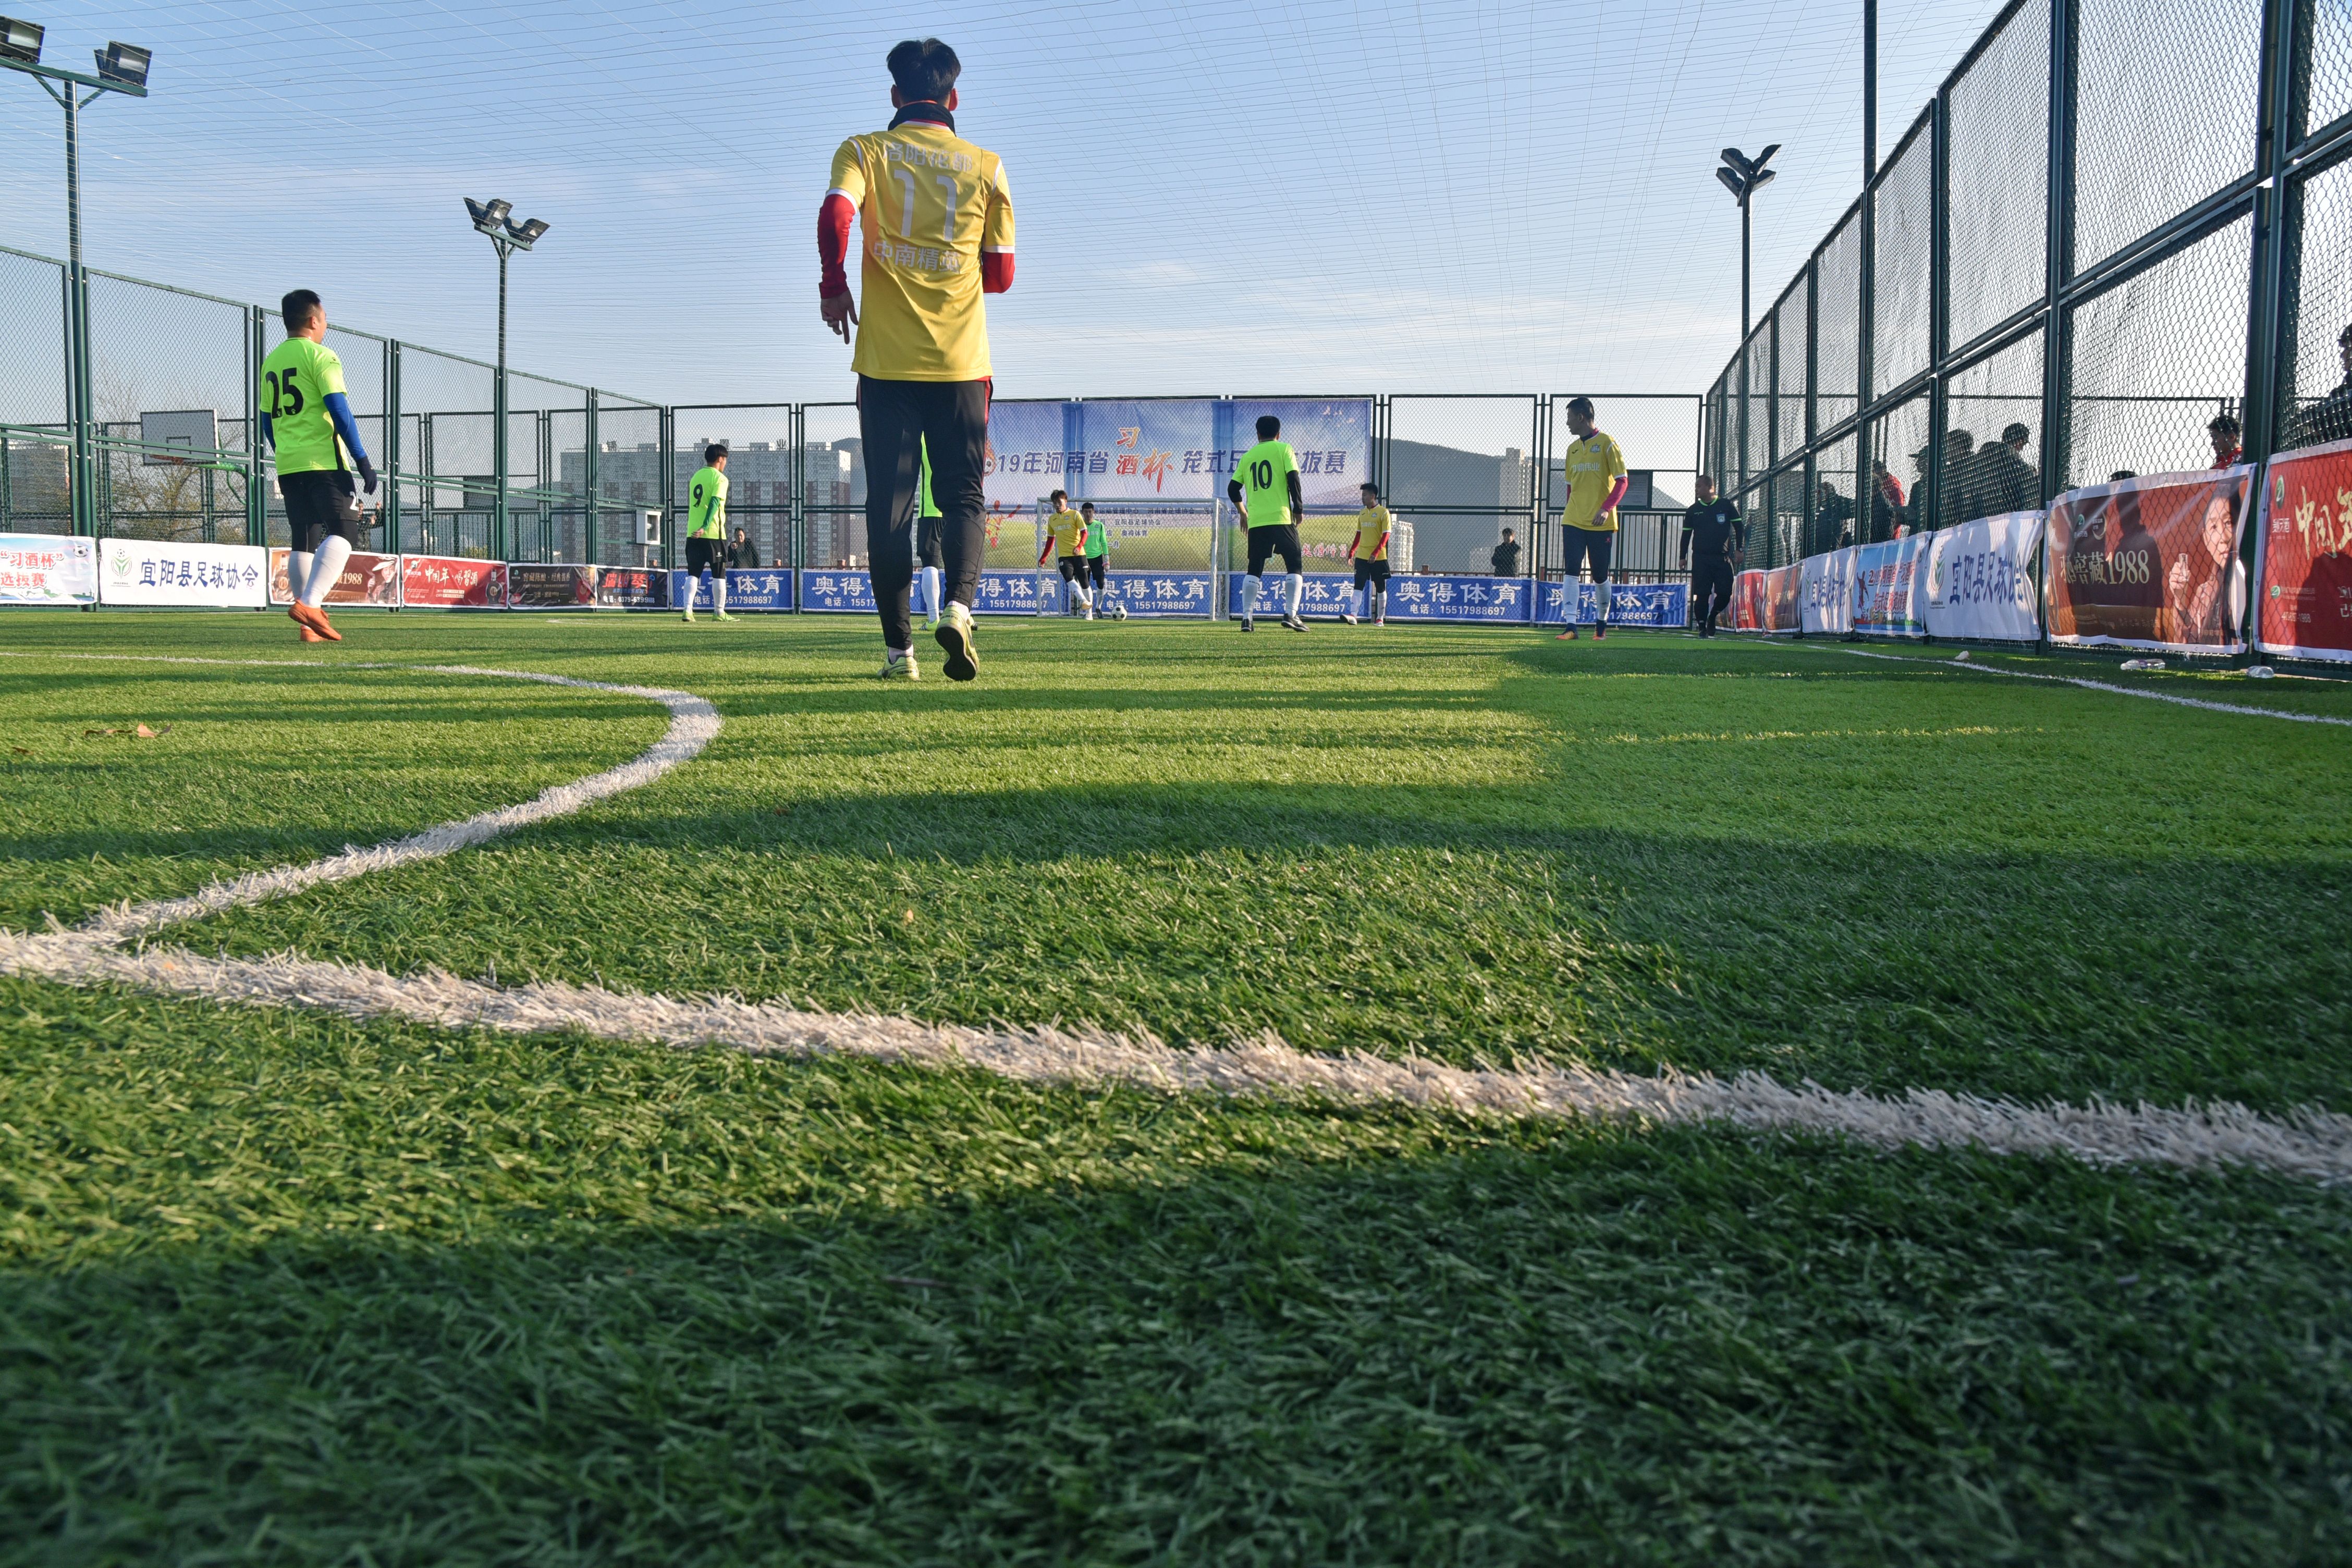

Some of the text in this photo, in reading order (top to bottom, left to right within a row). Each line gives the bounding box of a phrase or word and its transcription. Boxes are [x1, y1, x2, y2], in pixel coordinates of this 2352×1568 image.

[883, 141, 973, 173] 洛阳花都
[874, 240, 961, 274] 中南精英
[265, 366, 304, 419] 25
[1250, 459, 1272, 492] 10
[693, 483, 704, 508] 9
[1121, 529, 1148, 537] 奥得体育
[138, 559, 259, 589] 宜阳县足球协会
[1395, 580, 1522, 605] 奥得体育
[1410, 603, 1505, 616] 电话：15517988697
